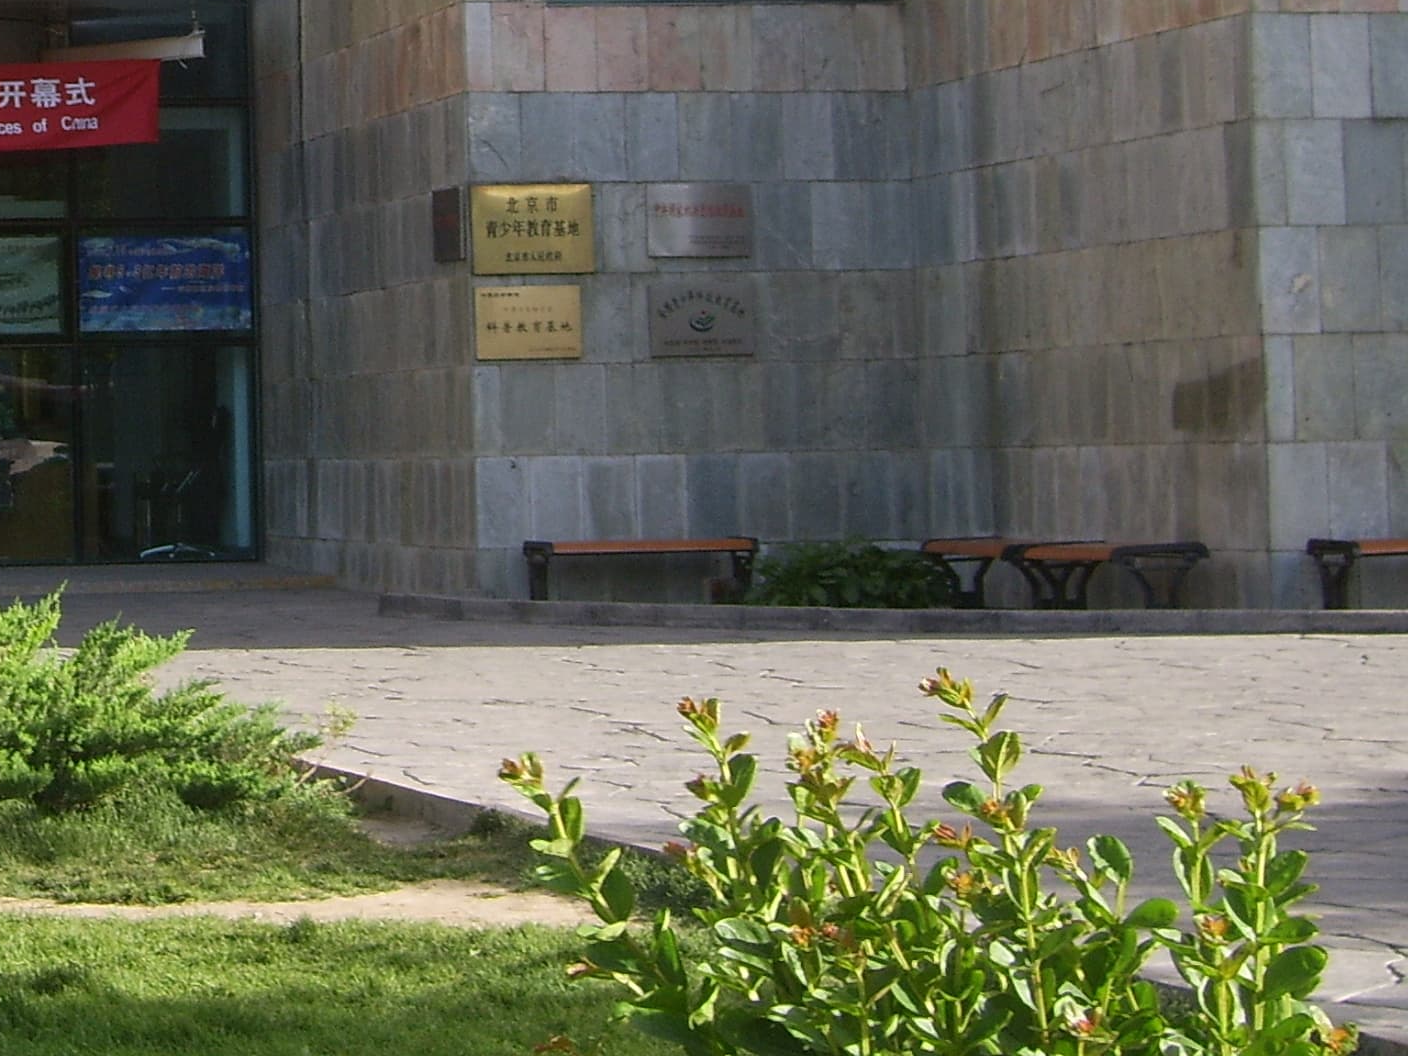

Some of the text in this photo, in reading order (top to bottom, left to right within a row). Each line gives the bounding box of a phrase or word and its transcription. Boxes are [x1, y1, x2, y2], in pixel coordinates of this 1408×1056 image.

[32, 117, 48, 133] of
[61, 116, 98, 132] China
[505, 196, 559, 214] 北京市
[486, 219, 580, 238] 青少年教育基地
